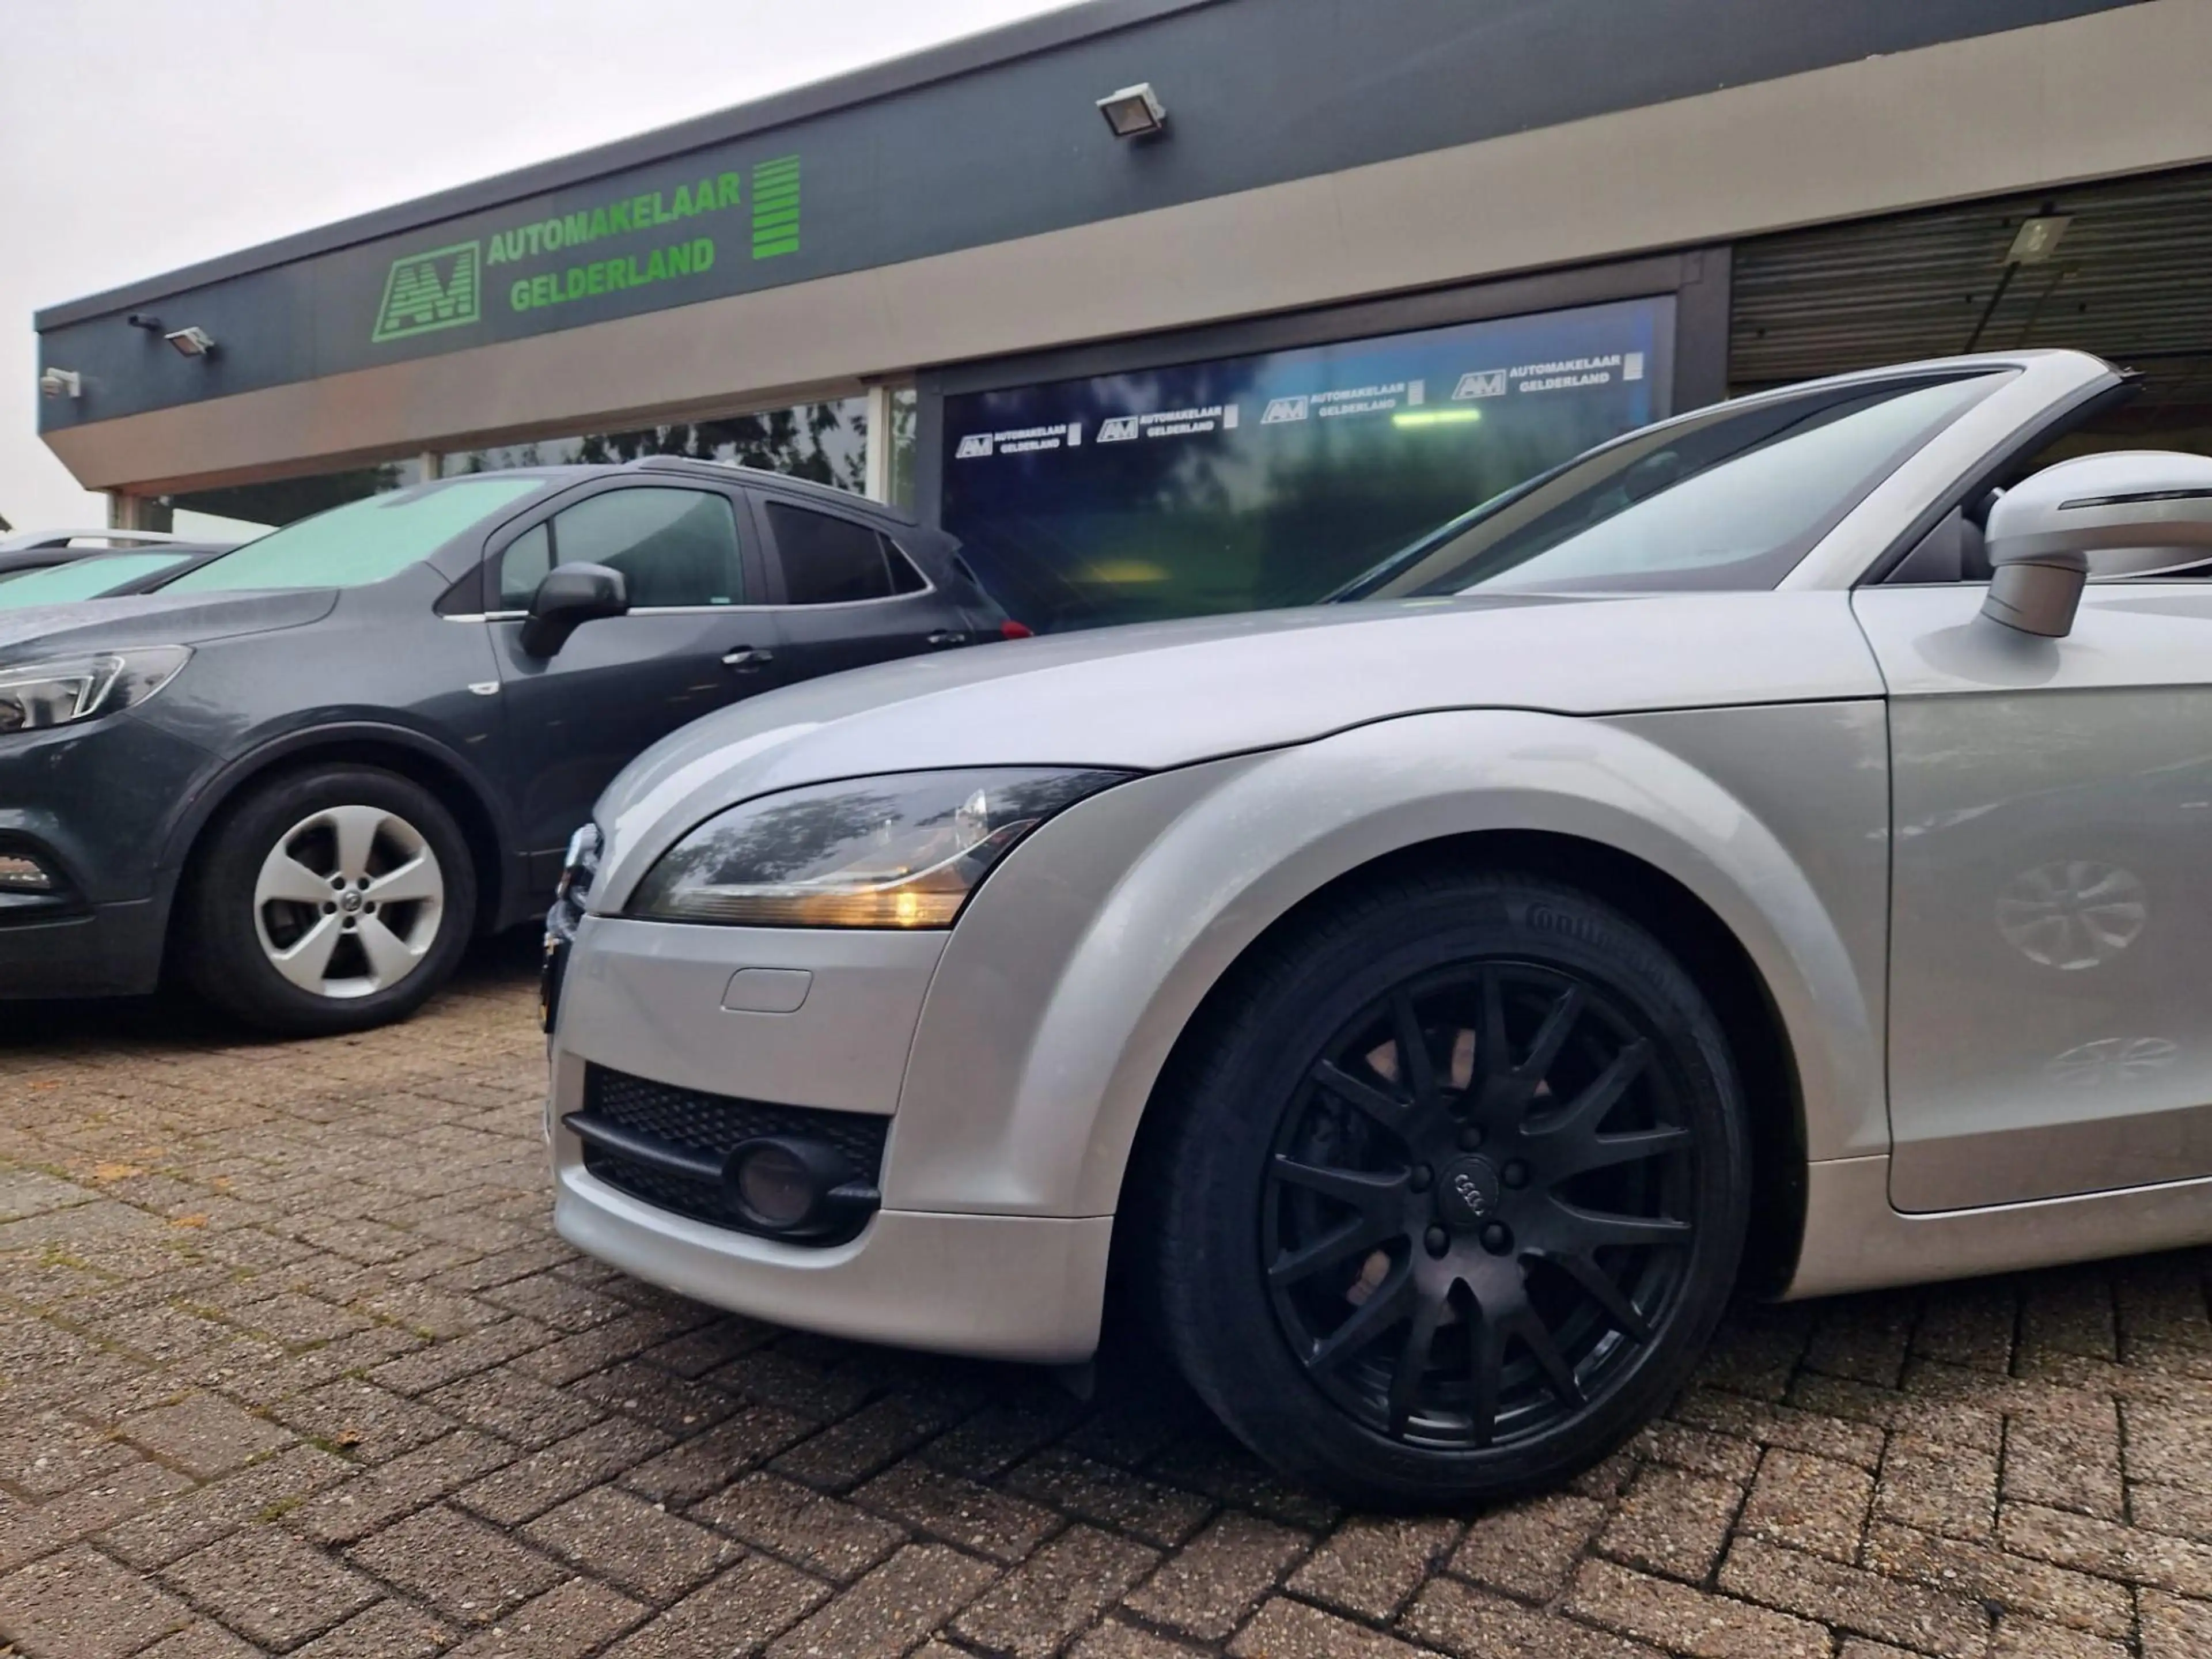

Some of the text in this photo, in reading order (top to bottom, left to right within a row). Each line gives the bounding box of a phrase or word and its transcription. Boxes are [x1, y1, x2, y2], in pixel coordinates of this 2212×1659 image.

[487, 172, 740, 265] AUTOMAKELAAR
[510, 238, 715, 312] GELDERLAND
[1509, 355, 1621, 378] AUTOMAKELAAR
[1519, 372, 1611, 393] GELDERLAND
